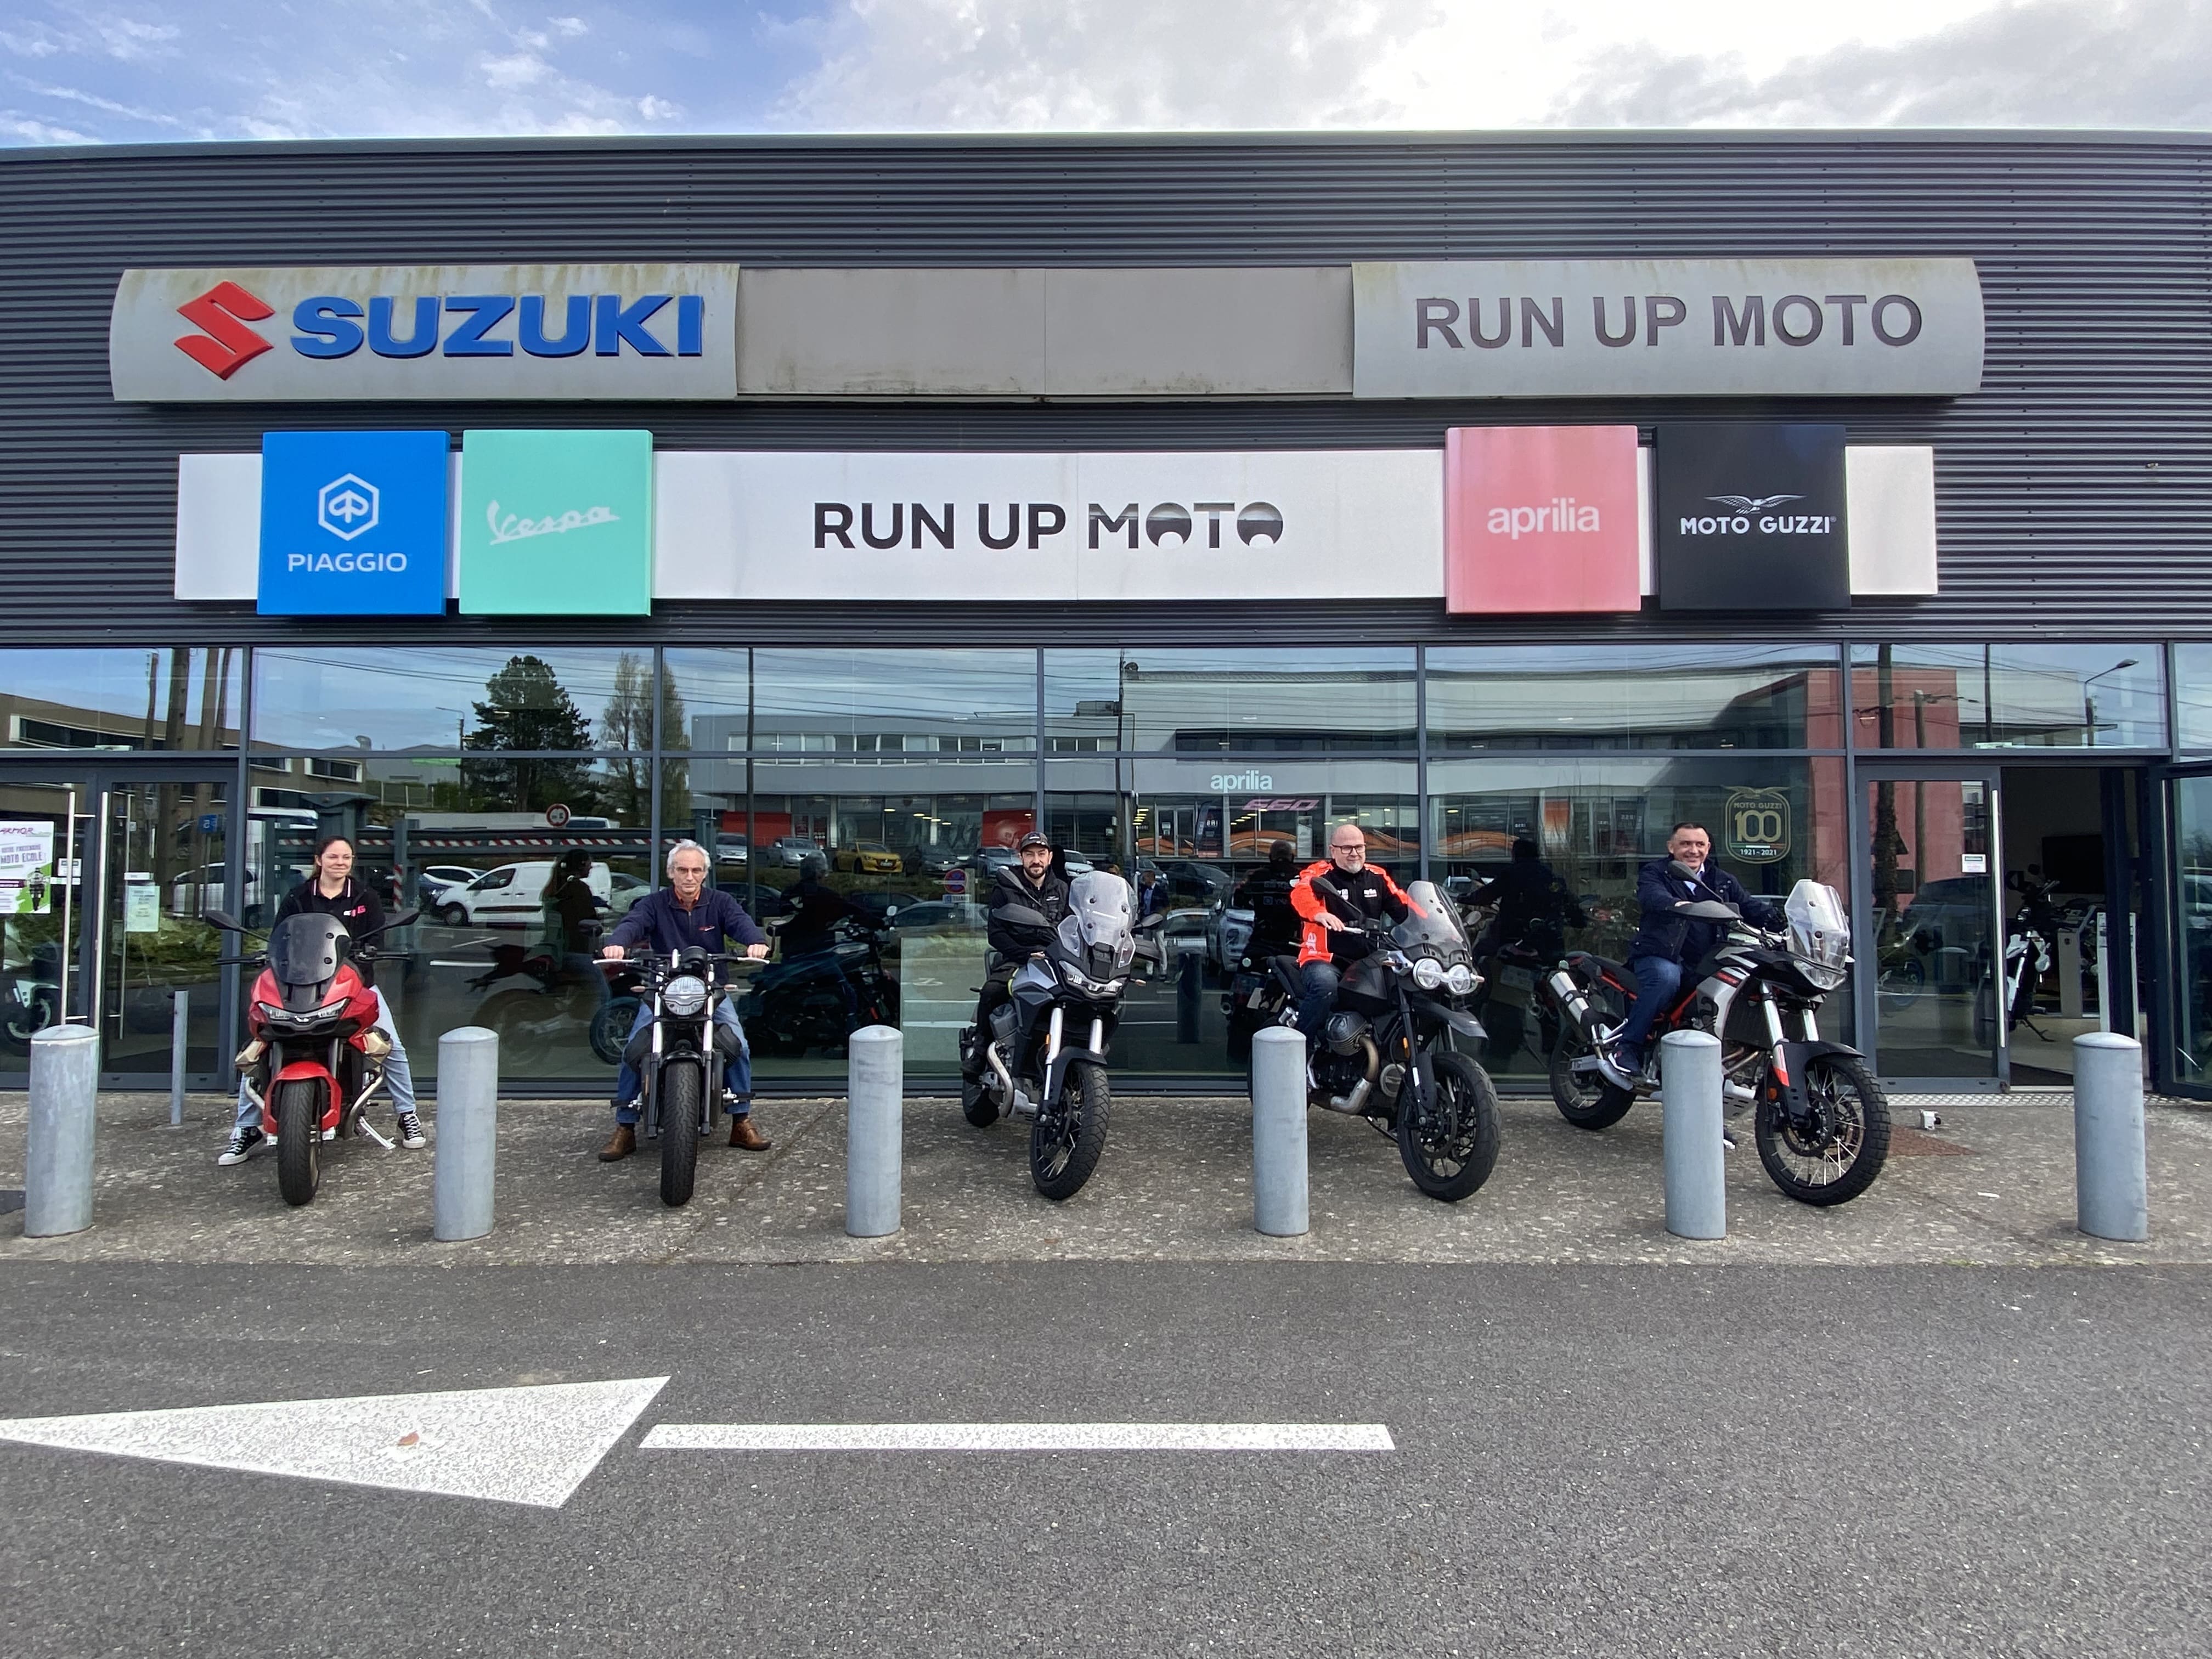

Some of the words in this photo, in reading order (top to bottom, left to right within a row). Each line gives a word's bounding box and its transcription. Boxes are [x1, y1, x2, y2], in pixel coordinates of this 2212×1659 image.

[290, 294, 704, 358] SUZUKI
[1415, 296, 1565, 349] RUN
[1592, 295, 1688, 348] UP
[1712, 294, 1923, 348] MOTO
[486, 500, 620, 545] Vespa
[814, 502, 955, 550] RUN
[978, 502, 1066, 550] UP
[1088, 501, 1284, 549] MOTO
[1487, 497, 1600, 540] aprilia
[1680, 516, 1750, 535] MOTO
[287, 552, 408, 572] PIAGGIO
[1210, 769, 1273, 794] aprilia
[1735, 810, 1782, 842] 100
[1, 853, 19, 864] MOTO
[22, 851, 43, 862] ECOLE
